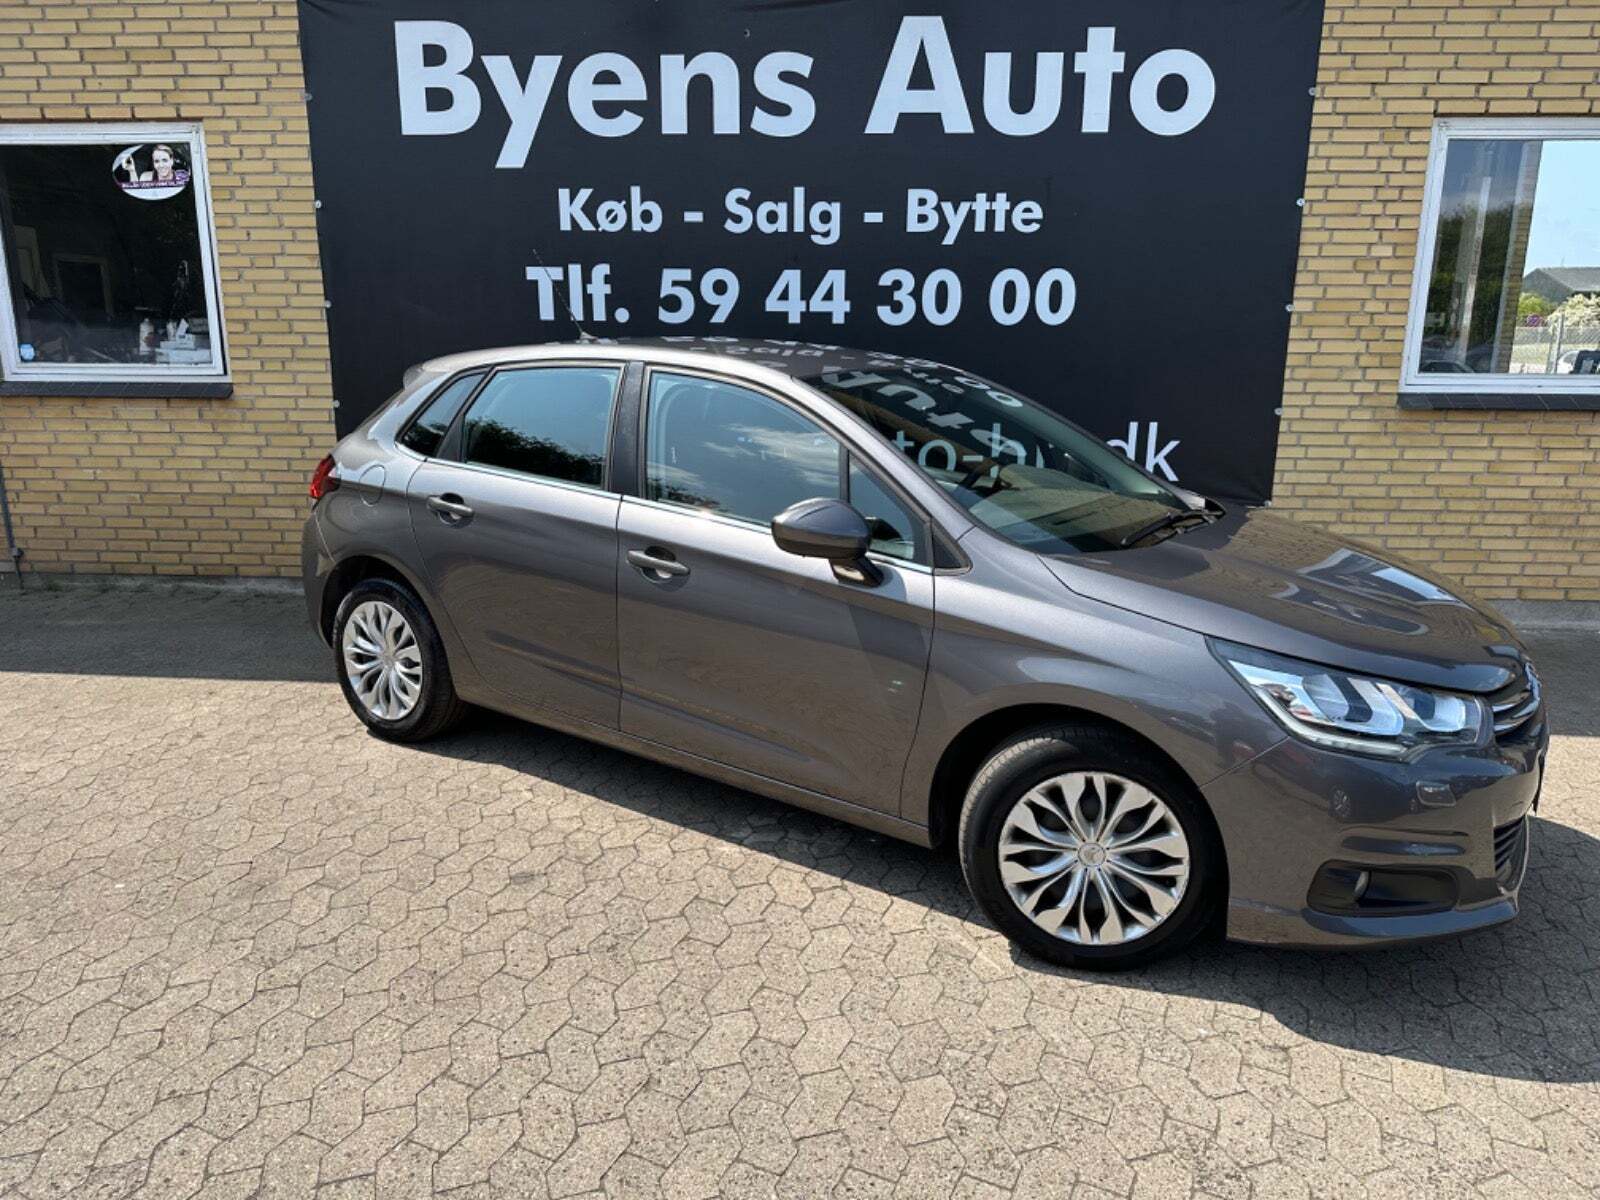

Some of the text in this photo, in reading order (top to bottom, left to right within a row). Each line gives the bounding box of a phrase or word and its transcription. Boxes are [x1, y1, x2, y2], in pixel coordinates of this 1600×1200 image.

[394, 15, 1216, 169] Byens Auto
[558, 185, 1044, 246] Køb - Salg - Bytte
[525, 263, 1077, 326] Tlf. 59 44 30 00
